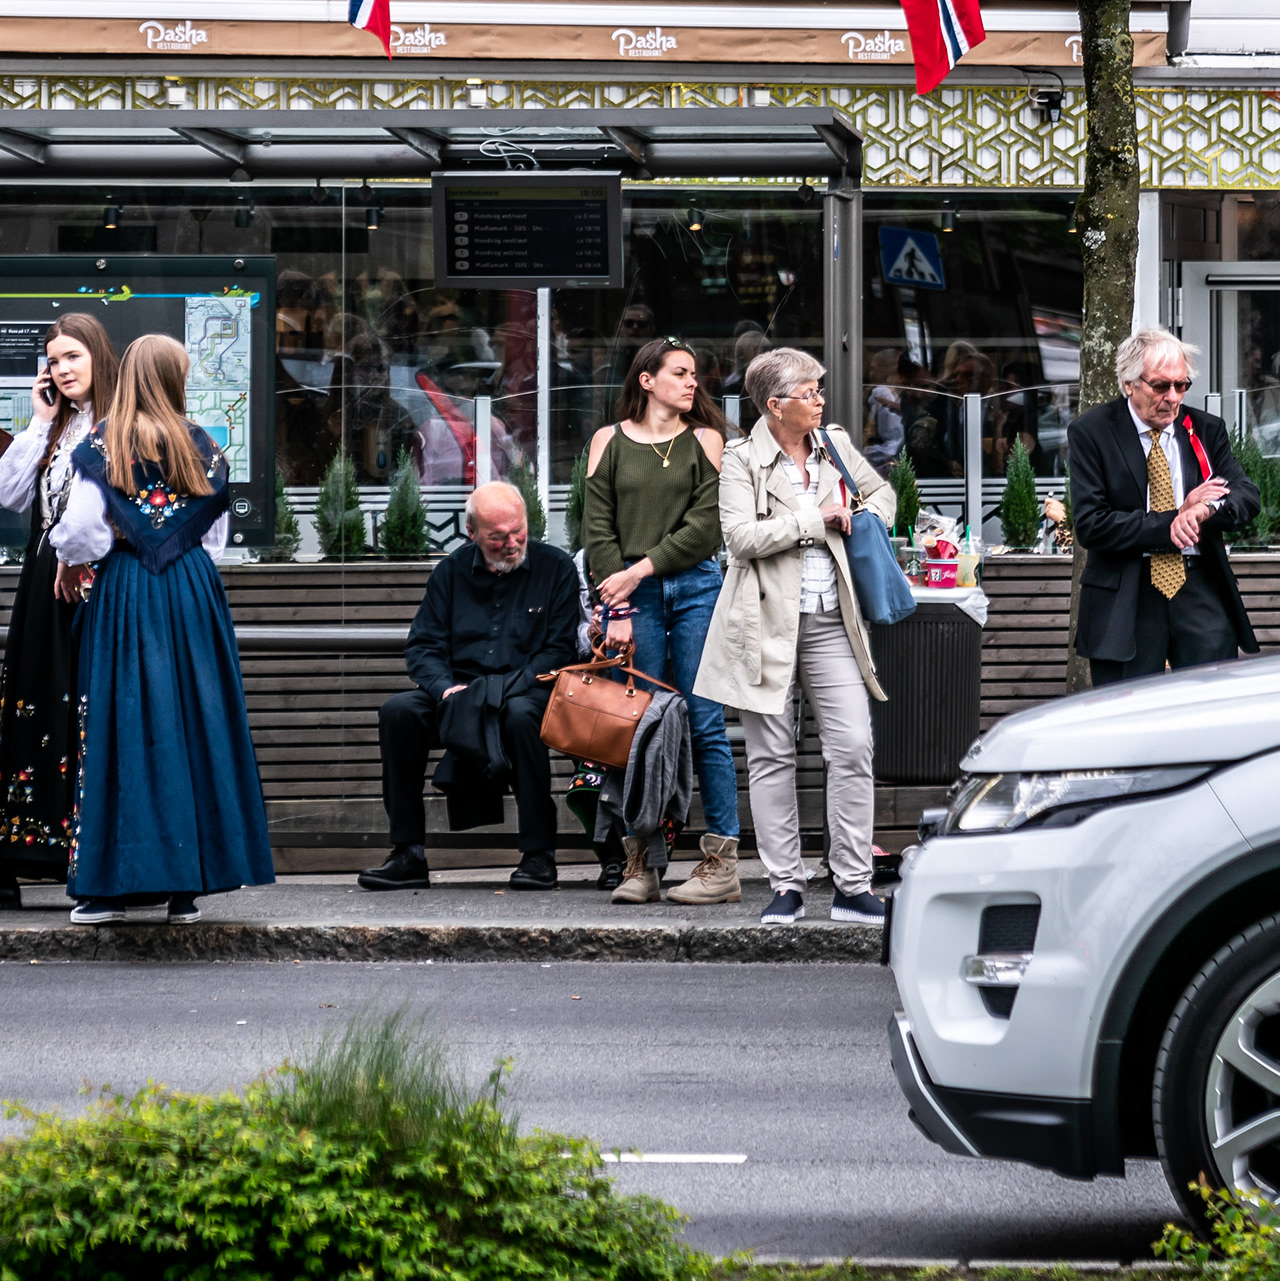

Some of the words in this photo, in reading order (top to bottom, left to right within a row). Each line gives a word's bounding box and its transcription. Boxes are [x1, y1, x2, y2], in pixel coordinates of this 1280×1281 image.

[138, 20, 208, 50] Pasha
[611, 28, 678, 57] Pasha
[840, 31, 906, 60] Pasha
